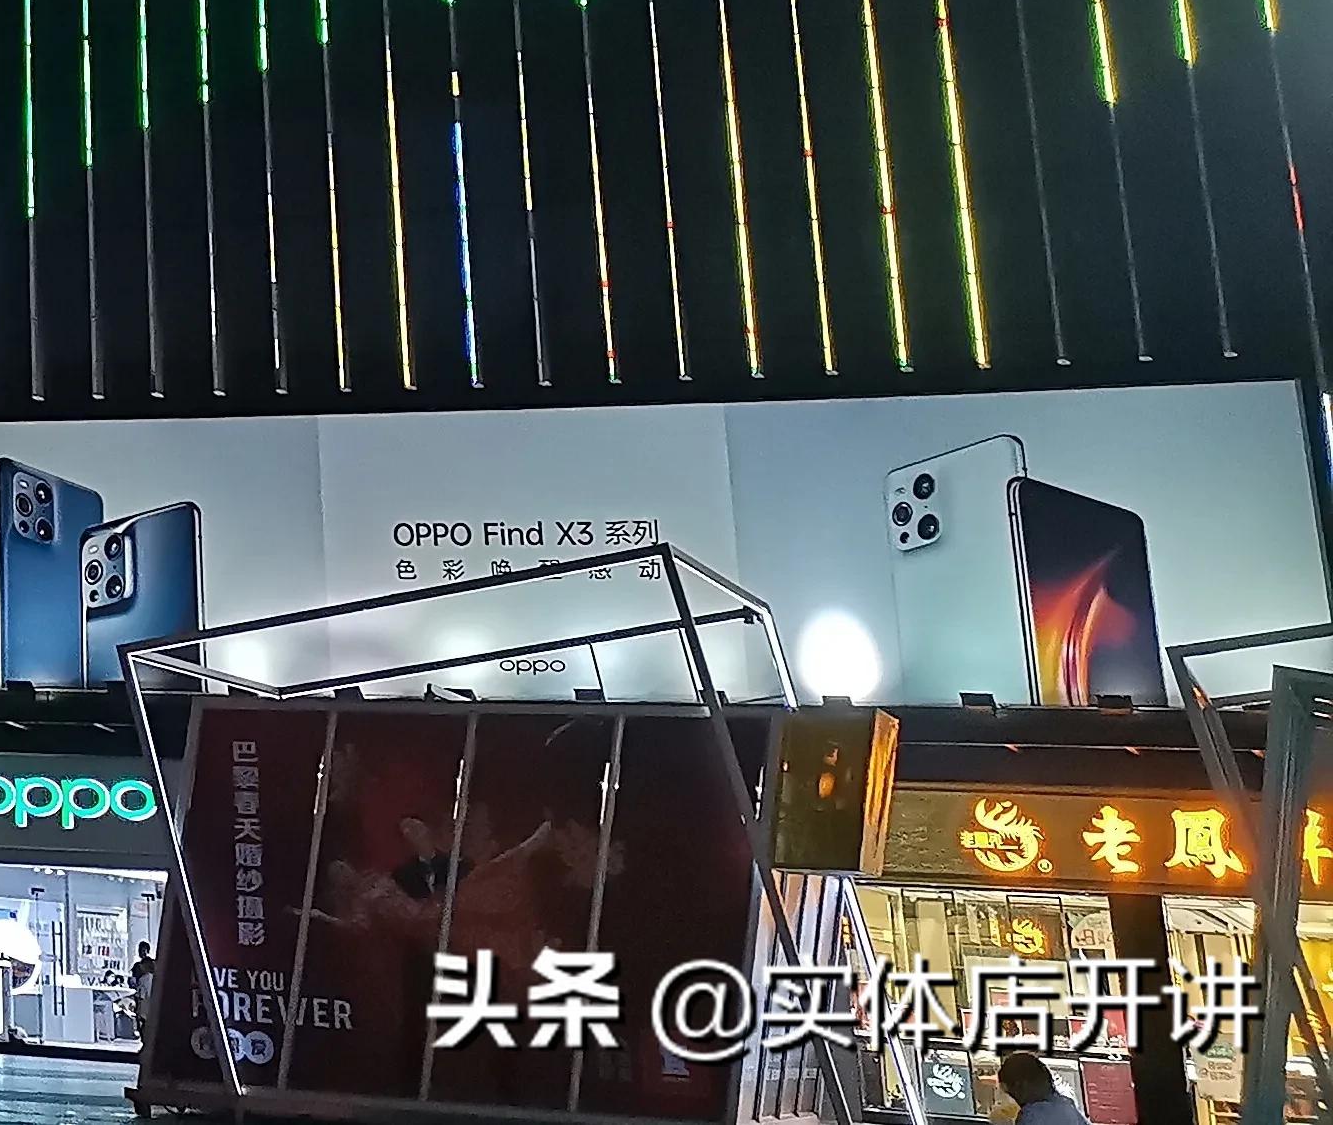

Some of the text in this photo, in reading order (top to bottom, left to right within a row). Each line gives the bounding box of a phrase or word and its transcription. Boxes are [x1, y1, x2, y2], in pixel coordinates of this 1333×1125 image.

[393, 518, 660, 547] OPPO Find X3 系列
[247, 969, 285, 992] YOU
